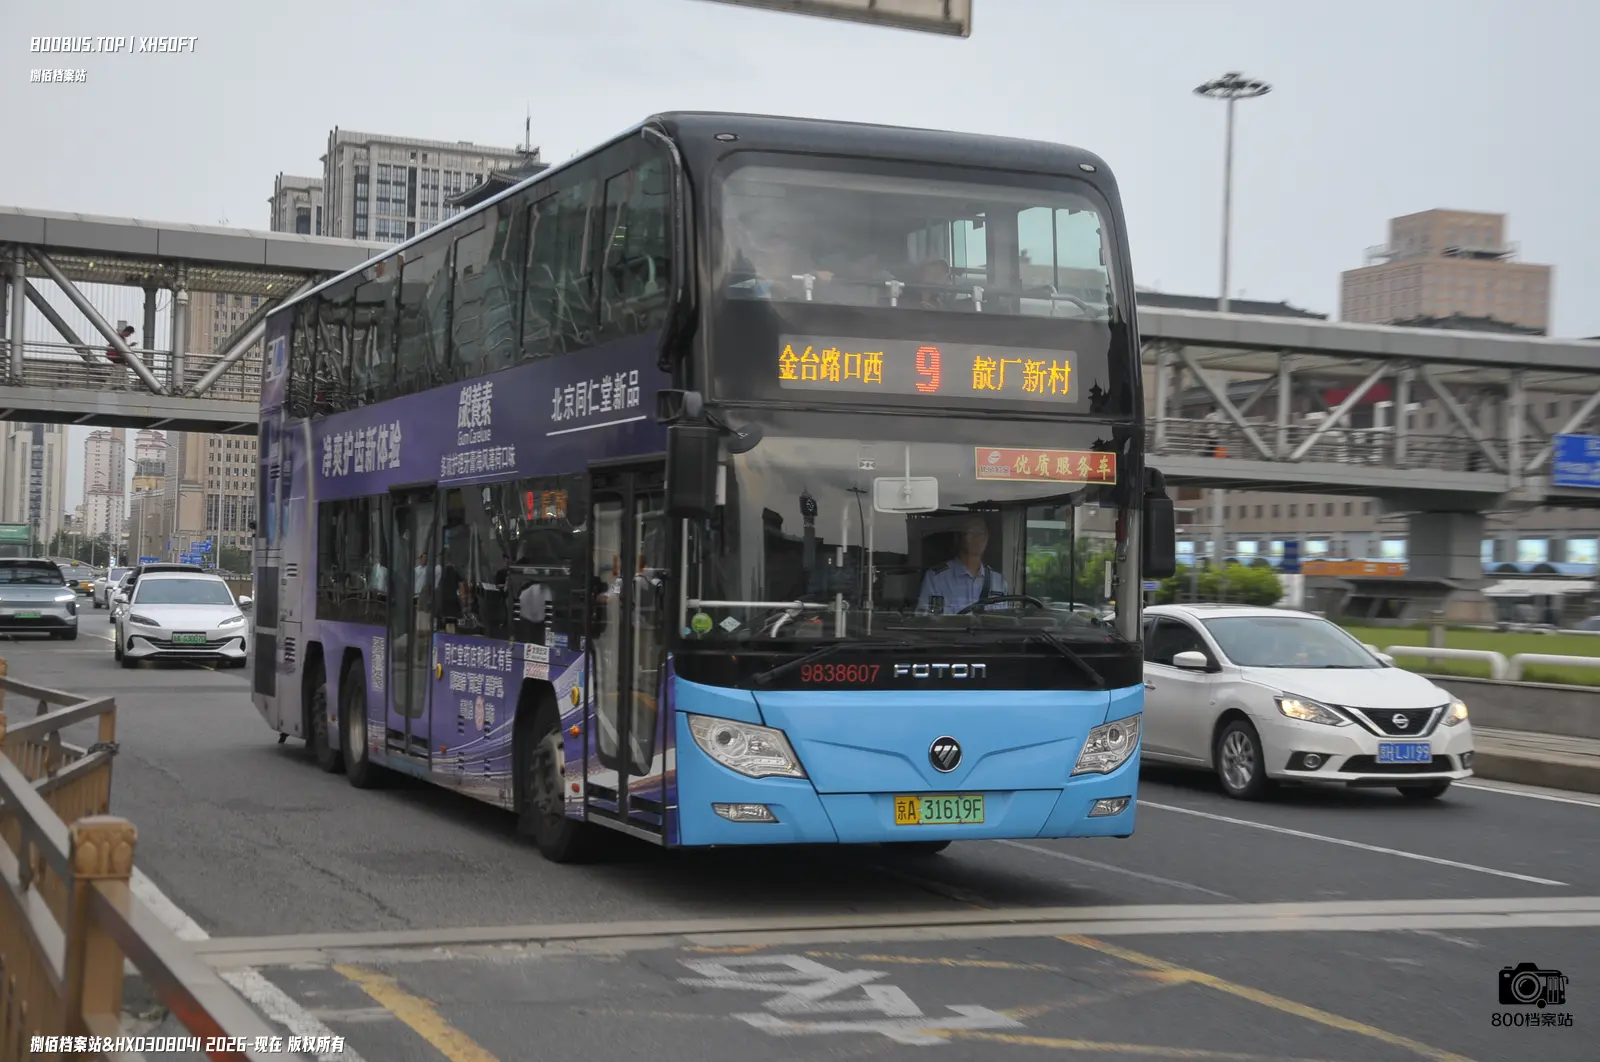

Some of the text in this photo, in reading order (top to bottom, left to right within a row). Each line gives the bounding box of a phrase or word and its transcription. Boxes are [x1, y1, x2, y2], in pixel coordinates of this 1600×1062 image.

[778, 344, 884, 384] 金台路口西
[915, 346, 941, 393] 9
[972, 356, 1072, 396] 靛厂新村
[551, 370, 640, 421] 北京同仁堂新品
[321, 419, 402, 478] 净爽护齿新体验
[1013, 453, 1111, 480] 优质服务车
[801, 664, 880, 683] 9838607
[893, 662, 987, 679] FOTON
